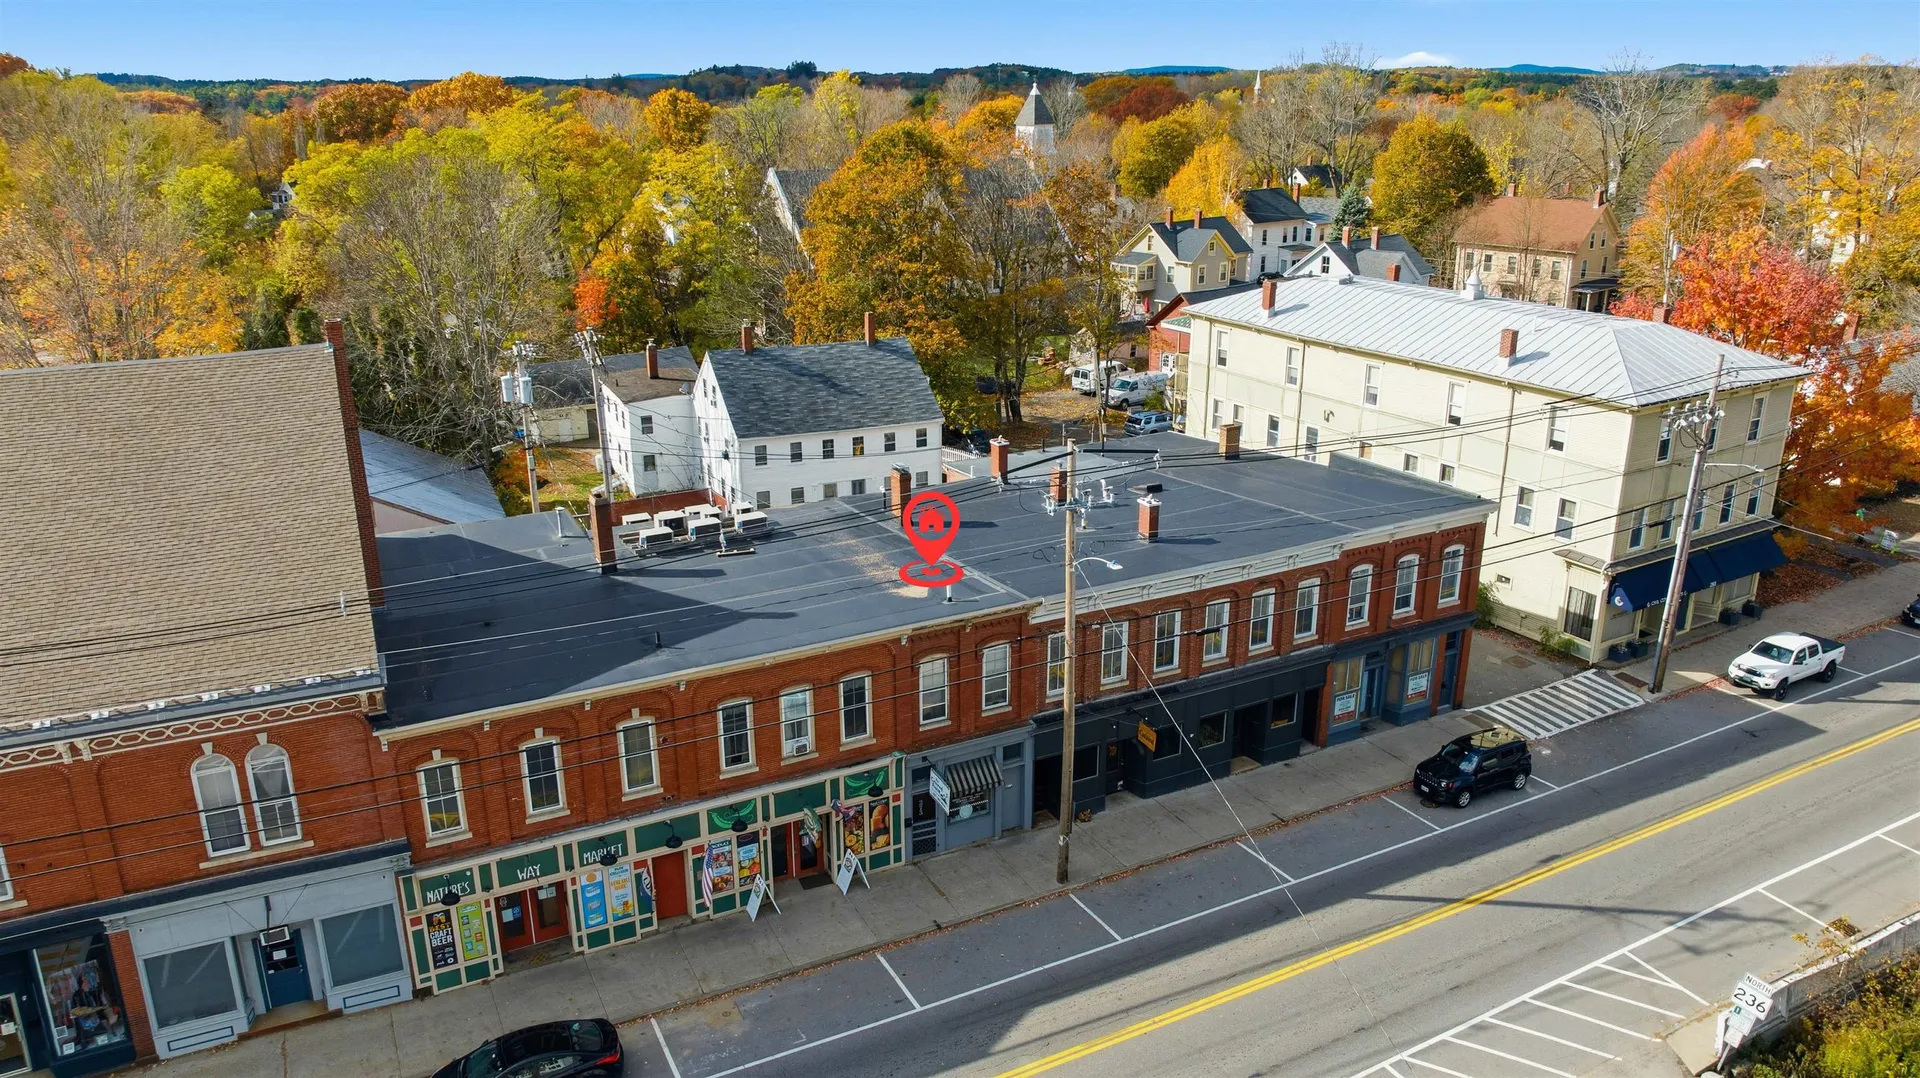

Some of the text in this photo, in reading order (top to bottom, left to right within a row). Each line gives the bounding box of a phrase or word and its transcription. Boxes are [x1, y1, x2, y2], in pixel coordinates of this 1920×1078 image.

[517, 863, 541, 881] WAY
[429, 924, 450, 932] BEST
[430, 927, 452, 940] CRAFT
[431, 935, 453, 947] BEER
[1745, 975, 1771, 995] NORTH
[1734, 988, 1766, 1013] 236
